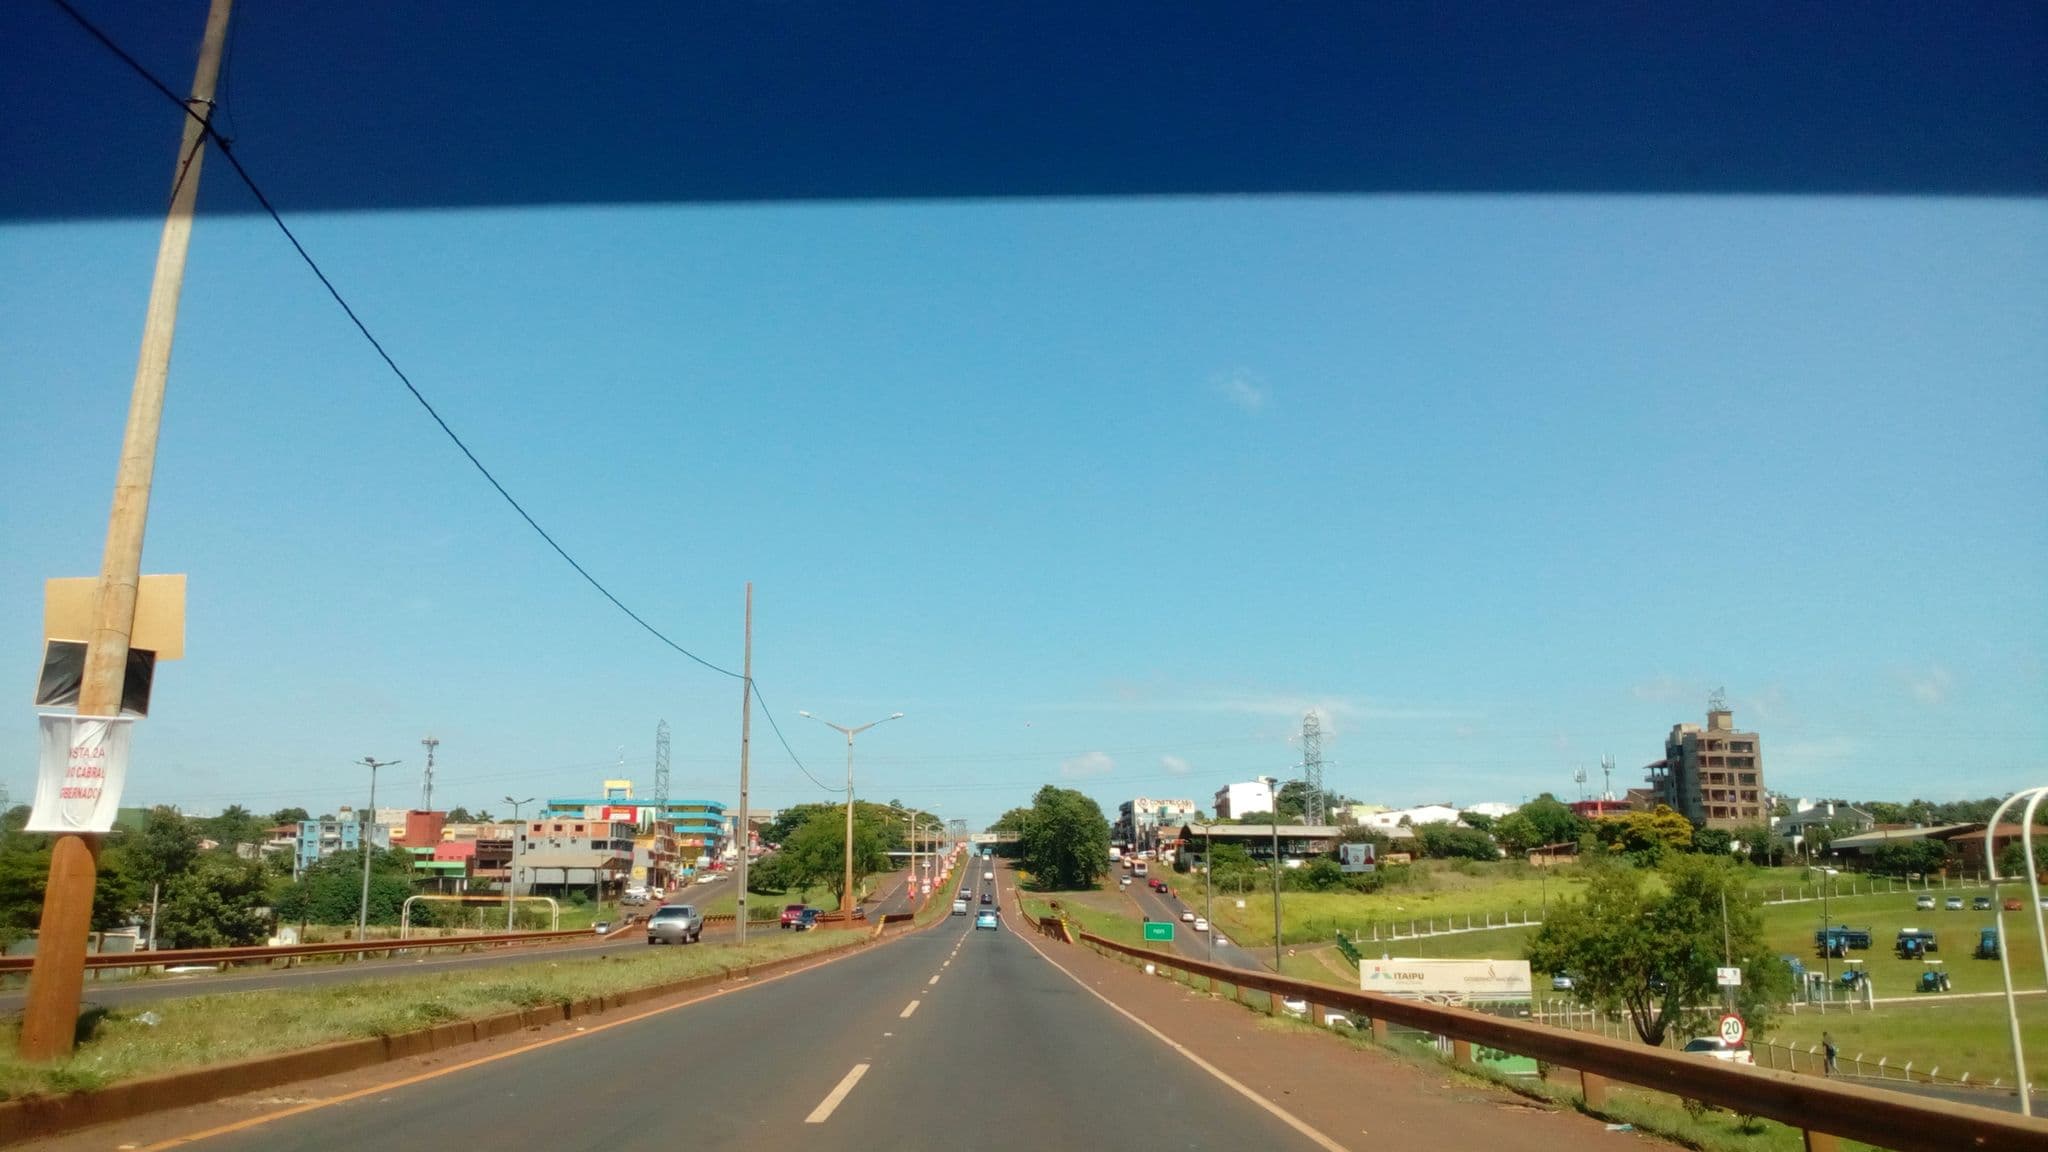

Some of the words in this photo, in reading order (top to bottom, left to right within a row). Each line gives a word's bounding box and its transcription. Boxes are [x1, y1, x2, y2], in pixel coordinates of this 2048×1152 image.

[76, 767, 105, 779] CABRAL
[1393, 972, 1425, 980] ITAIPU
[1724, 1020, 1740, 1035] 20
